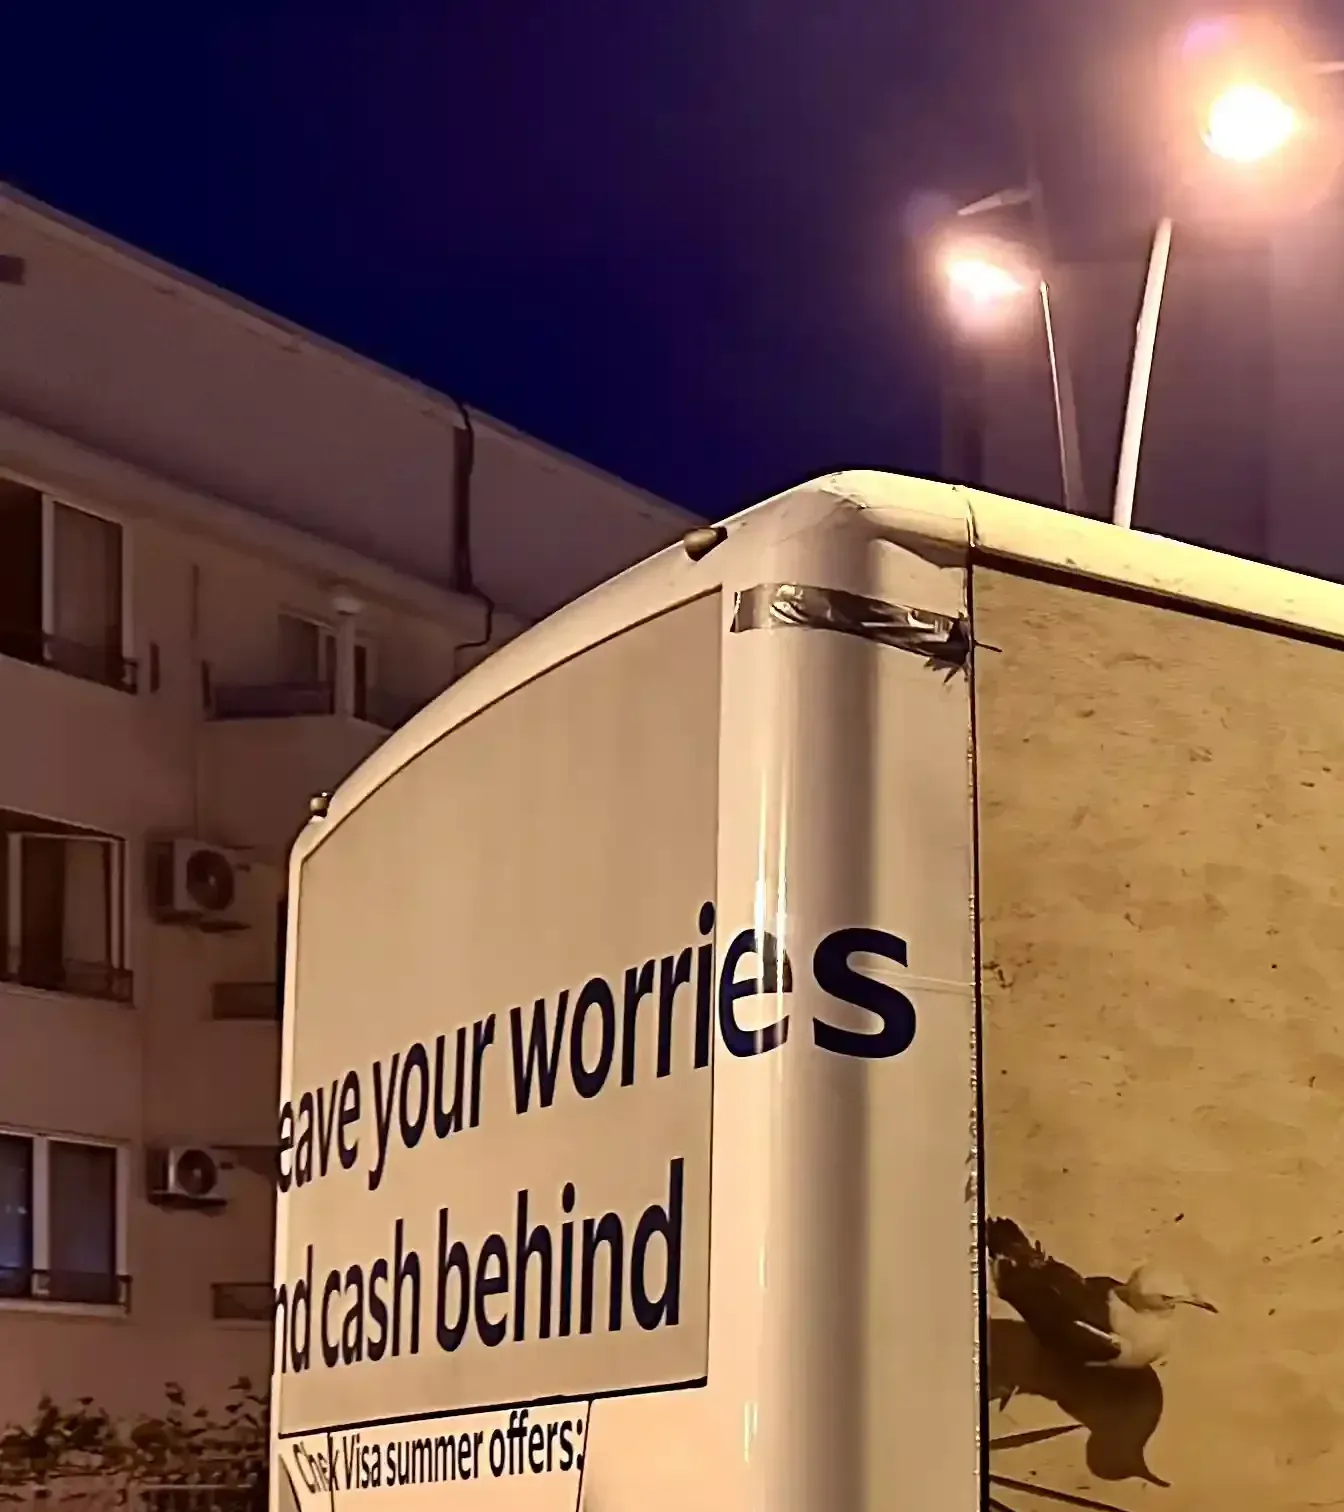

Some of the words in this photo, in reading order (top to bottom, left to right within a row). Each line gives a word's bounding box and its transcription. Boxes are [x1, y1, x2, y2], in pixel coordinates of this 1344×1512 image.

[277, 1070, 361, 1193] eave
[368, 1012, 496, 1191] your
[509, 901, 918, 1115] worries
[274, 1244, 314, 1373] nd
[321, 1218, 420, 1368] cash
[436, 1156, 685, 1352] behind
[342, 1432, 381, 1490] Visa
[386, 1430, 484, 1487] summer
[489, 1408, 584, 1478] offers:
